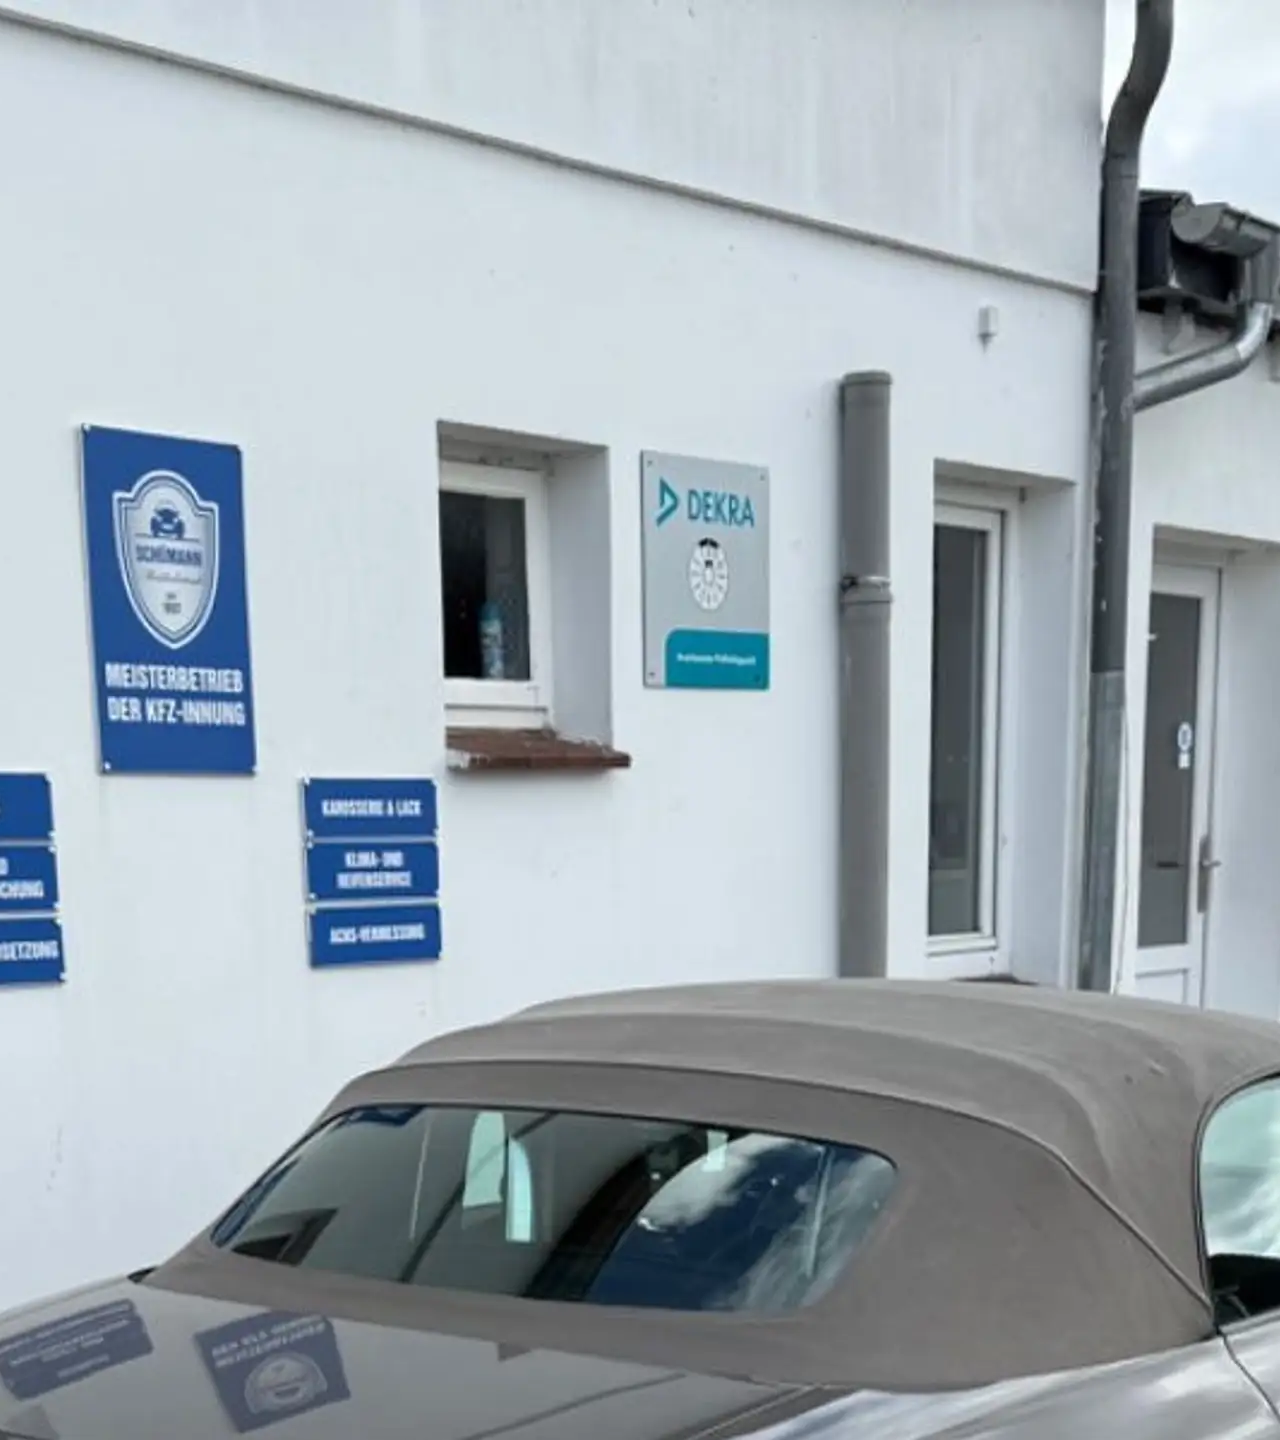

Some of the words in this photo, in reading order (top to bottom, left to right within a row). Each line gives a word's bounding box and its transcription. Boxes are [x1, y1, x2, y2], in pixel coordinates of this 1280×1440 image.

[687, 489, 754, 528] DEKRA
[105, 662, 244, 693] MEISTERBETRIEB
[107, 696, 141, 721] DER
[146, 698, 246, 726] KFZ-INNUNG
